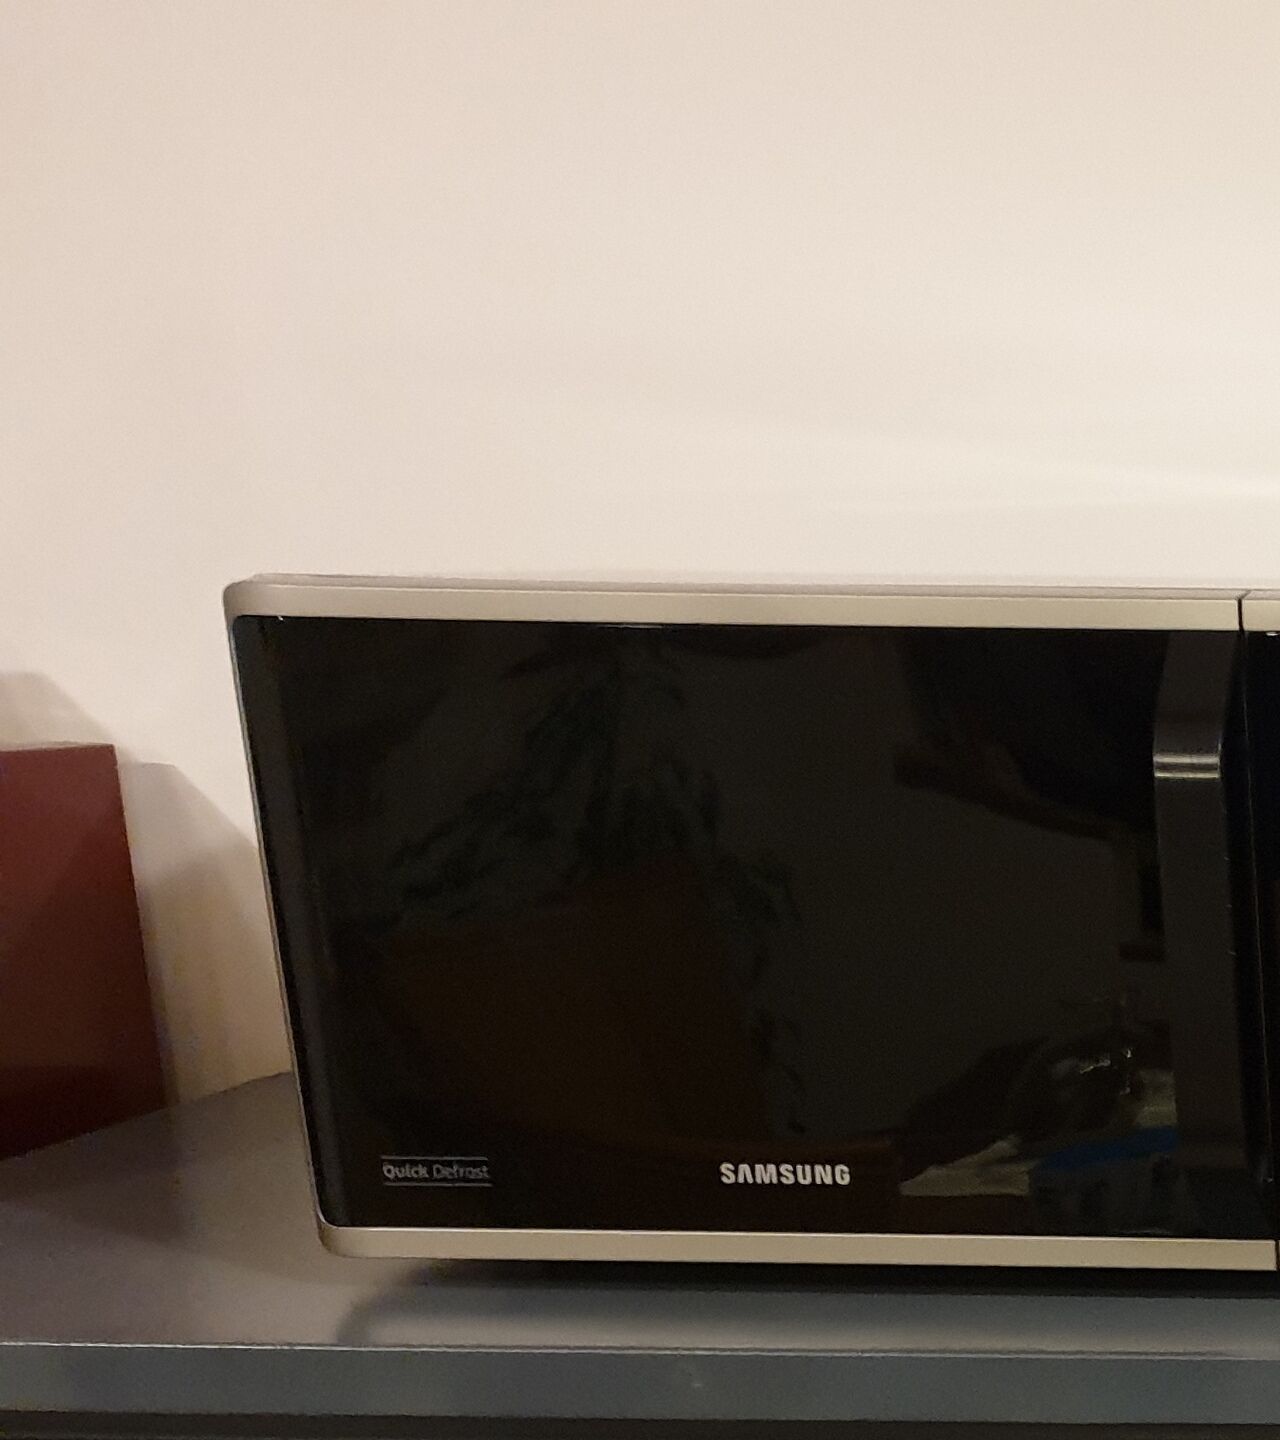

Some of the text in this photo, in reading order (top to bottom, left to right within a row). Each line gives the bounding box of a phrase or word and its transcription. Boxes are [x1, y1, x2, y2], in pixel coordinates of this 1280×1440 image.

[382, 1161, 489, 1180] Quick Defrost
[719, 1161, 850, 1186] SAMSUNG
